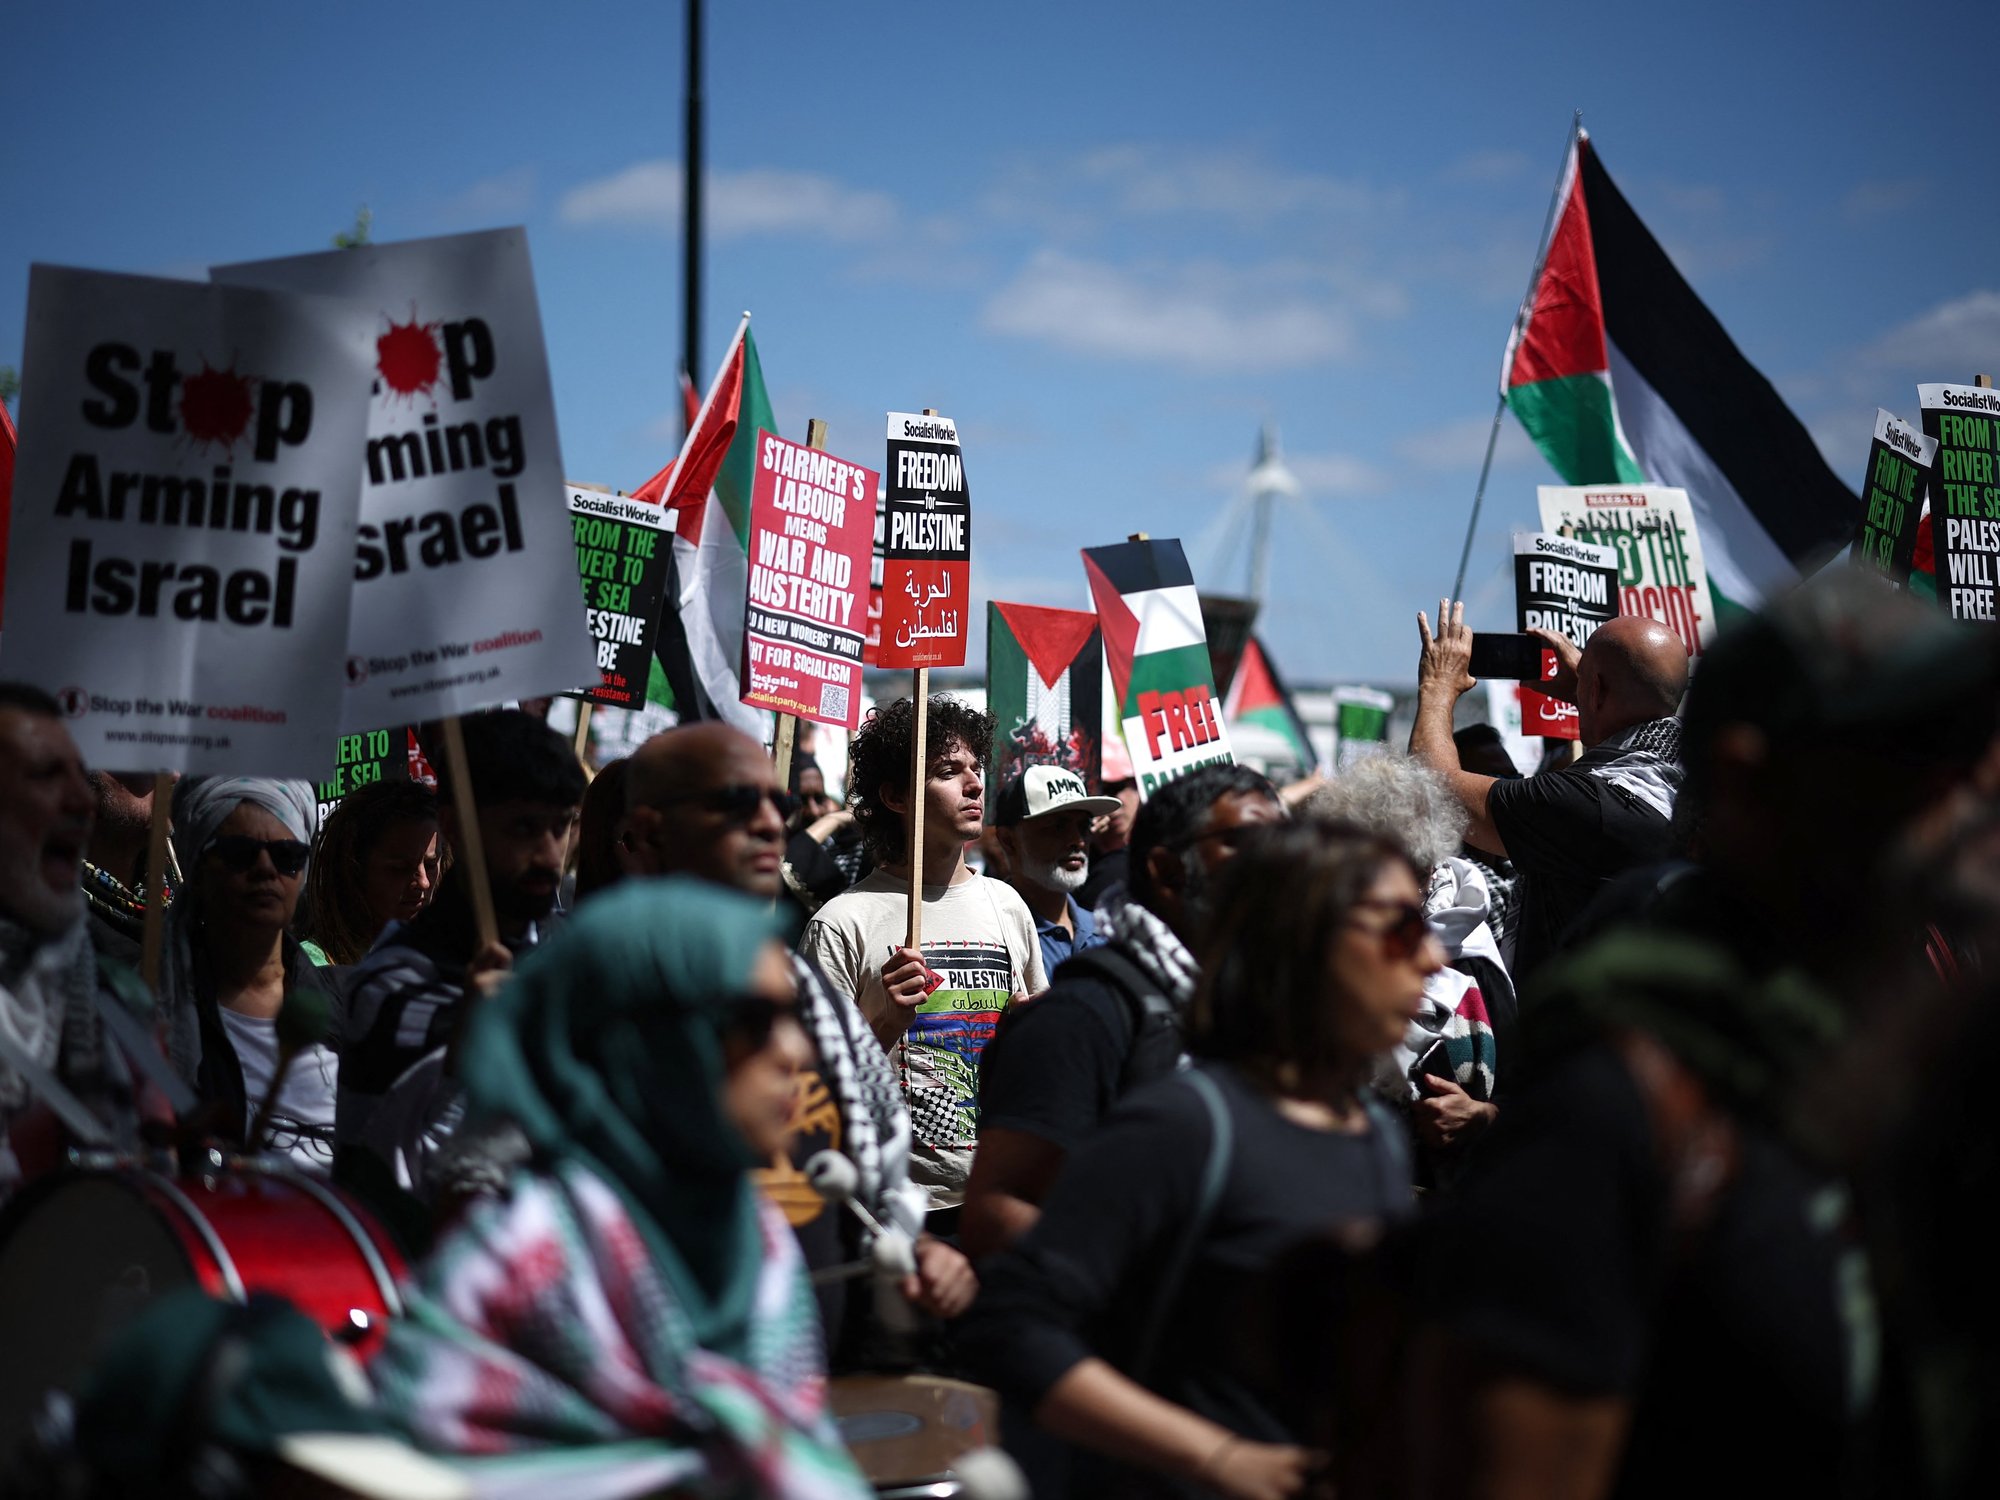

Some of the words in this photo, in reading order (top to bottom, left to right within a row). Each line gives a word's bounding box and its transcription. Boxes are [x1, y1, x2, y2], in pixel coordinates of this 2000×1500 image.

[82, 343, 314, 462] Stop
[1943, 390, 1988, 411] Socialist
[366, 413, 526, 486] ming
[904, 420, 934, 439] Socialist
[934, 423, 956, 441] Worker
[1939, 414, 1990, 449] FROM
[763, 437, 866, 500] STARMER'S
[897, 450, 962, 492] FREEDOM
[1899, 462, 1918, 503] THE
[1942, 449, 1994, 484] RIVER
[55, 453, 321, 553] Arming
[573, 494, 624, 517] Socialist
[625, 504, 661, 525] Worker
[773, 475, 846, 528] LABOUR
[925, 491, 936, 510] for
[1892, 500, 1905, 538] TO
[1944, 483, 1980, 517] THE
[354, 482, 525, 582] srael
[627, 527, 658, 559] THE
[784, 515, 827, 545] MEANS
[890, 511, 965, 552] PALESTINE
[1536, 538, 1574, 557] Socialist
[1947, 518, 2000, 553] PALES
[576, 546, 617, 580] VER
[623, 556, 644, 586] TO
[759, 528, 806, 575] WAR
[810, 545, 852, 589] AND
[1644, 528, 1696, 587] THE
[1948, 553, 1993, 587] WILL
[65, 539, 298, 629] Israel
[595, 582, 631, 614] SEA
[750, 564, 855, 626] AUSTERITY
[905, 569, 951, 608] الحرية
[1529, 561, 1608, 606] FREEDOM
[1951, 588, 1997, 621] FREE
[586, 608, 646, 646] ESTINE
[757, 615, 763, 631] A
[764, 617, 788, 636] NEW
[790, 622, 832, 648] WORKERS'
[833, 635, 861, 656] PARTY
[895, 609, 958, 648] لفلسطين
[1526, 610, 1606, 649] PALESTI
[368, 656, 408, 676] Stop
[411, 650, 438, 667] the
[440, 643, 470, 660] War
[473, 629, 543, 654] coalition
[596, 640, 620, 670] BE
[765, 645, 792, 668] FOR
[793, 651, 851, 685] SOCIALISM
[613, 674, 627, 687] the
[752, 681, 779, 694] arty
[90, 696, 132, 717] Stop
[135, 698, 164, 715] the
[168, 699, 204, 717] War
[207, 703, 287, 724] coalition
[1137, 684, 1220, 761] FREE
[367, 729, 389, 759] TO
[948, 970, 1010, 991] PALESTINE
